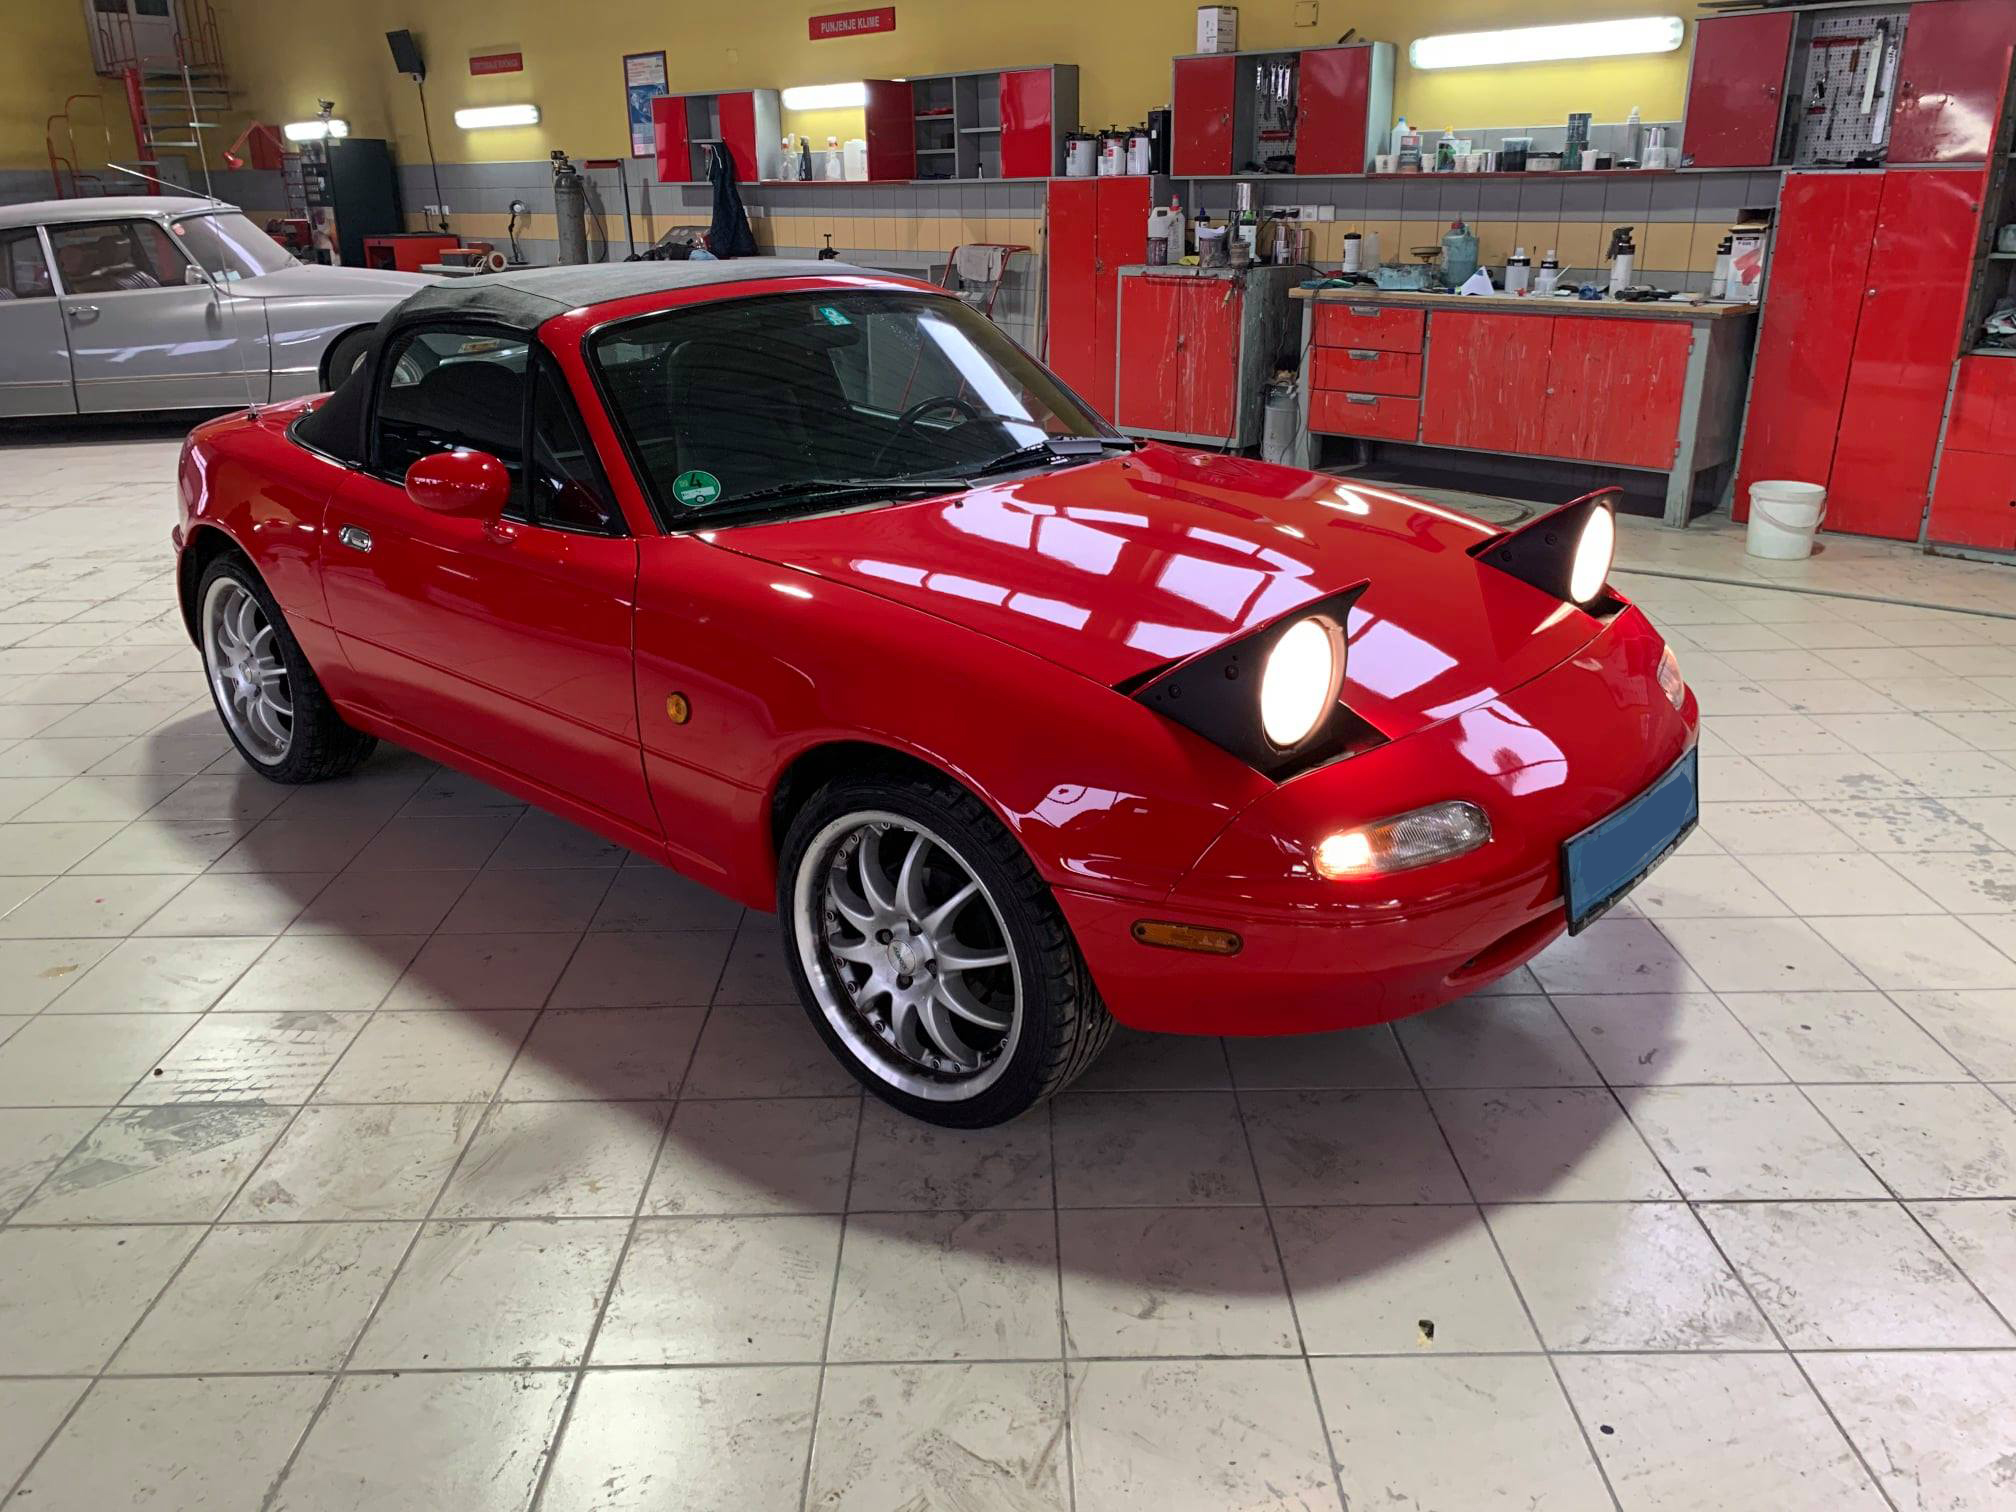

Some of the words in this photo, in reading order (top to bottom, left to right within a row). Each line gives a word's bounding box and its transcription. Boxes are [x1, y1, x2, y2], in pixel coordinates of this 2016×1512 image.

[821, 19, 856, 33] PUNJENJE
[857, 16, 880, 29] KLIME
[690, 473, 702, 487] 4
